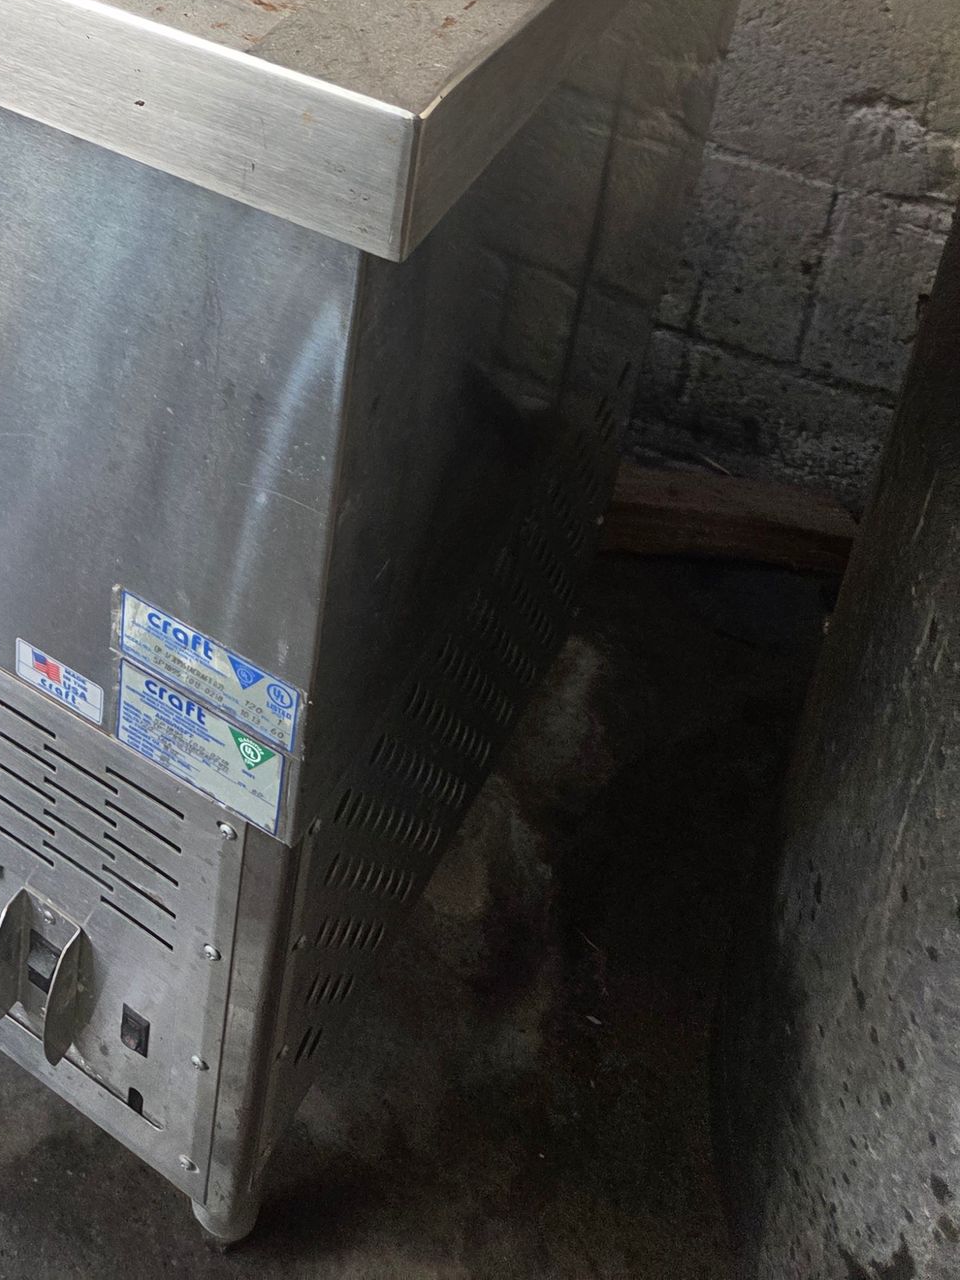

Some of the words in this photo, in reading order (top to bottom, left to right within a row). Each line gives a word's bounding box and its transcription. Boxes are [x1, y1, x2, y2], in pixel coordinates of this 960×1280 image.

[147, 612, 213, 661] craft
[40, 678, 76, 705] craft
[63, 680, 88, 702] USA
[145, 679, 206, 726] craft
[266, 700, 292, 720] LISTED
[244, 745, 256, 760] UL
